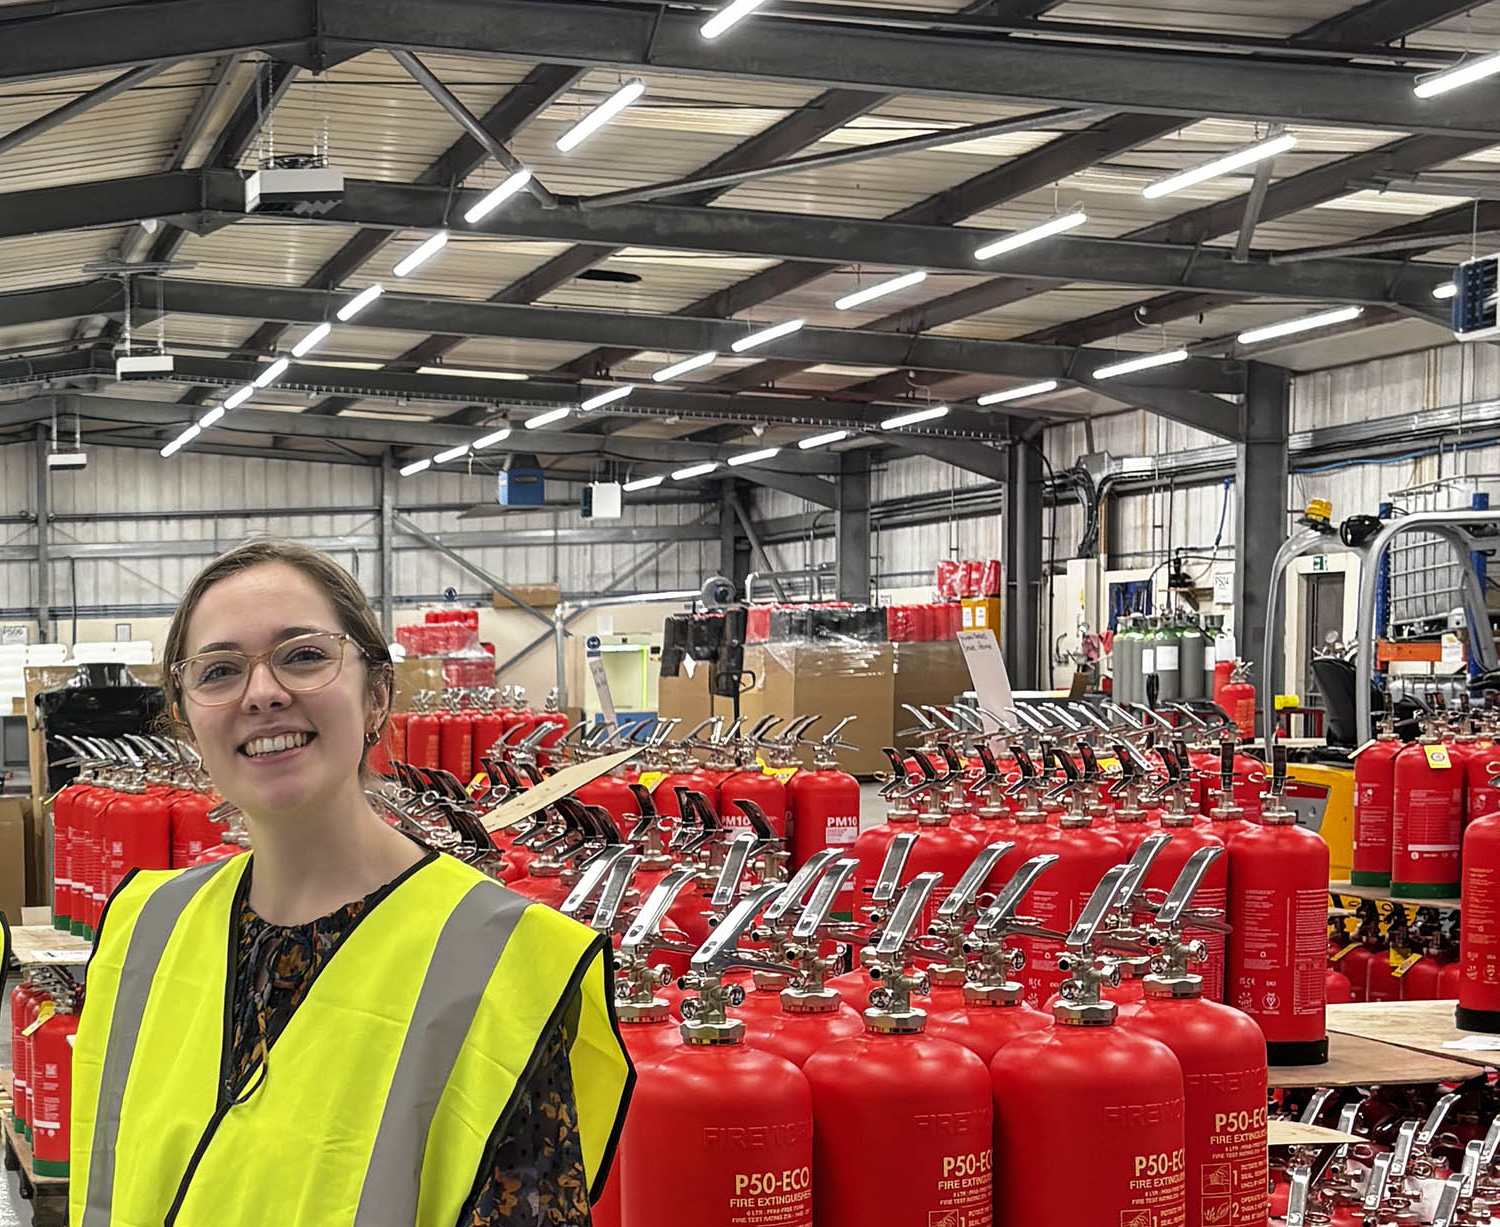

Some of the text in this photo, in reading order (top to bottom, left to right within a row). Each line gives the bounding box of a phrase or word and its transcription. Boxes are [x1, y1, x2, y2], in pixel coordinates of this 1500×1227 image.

[827, 816, 858, 827] PM10
[1215, 1107, 1266, 1133] P50-EC
[1210, 1135, 1232, 1145] FIRE
[943, 1149, 992, 1177] P50-EC
[1134, 1148, 1184, 1177] P50-EC
[735, 1166, 810, 1196] P50-ECO
[938, 1179, 960, 1191] FIRE
[1130, 1179, 1152, 1190] FIRE
[1233, 1170, 1238, 1186] 1
[730, 1198, 755, 1208] FIRE
[1232, 1202, 1240, 1218] 2
